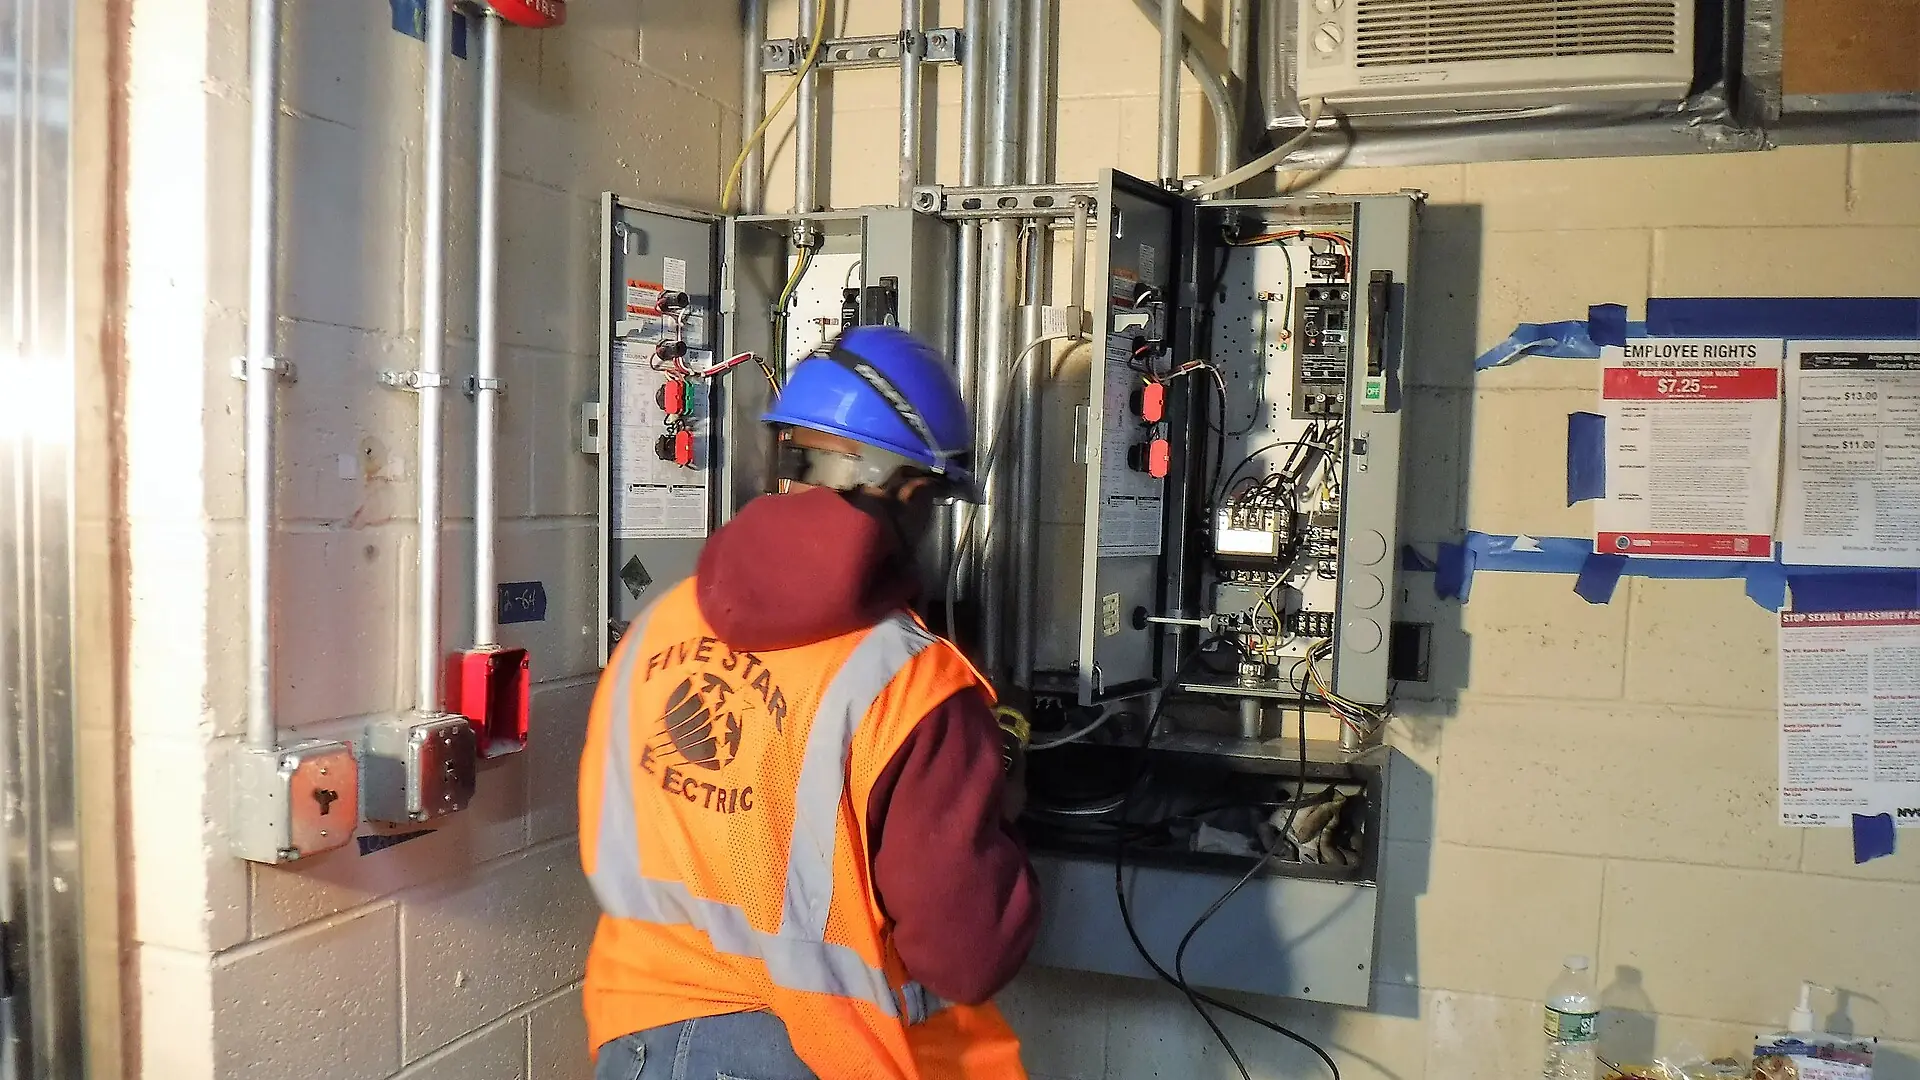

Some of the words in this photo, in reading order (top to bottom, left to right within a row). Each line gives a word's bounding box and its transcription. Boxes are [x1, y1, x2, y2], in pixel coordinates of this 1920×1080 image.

[1623, 345, 1699, 358] EMPLOYEE
[1703, 345, 1757, 358] RIGHTS
[1367, 387, 1380, 395] OFF
[1657, 378, 1701, 394] $7.25
[1844, 391, 1878, 401] $13.00
[1842, 440, 1876, 449] $11.00
[1783, 614, 1806, 623] STOP
[1808, 613, 1843, 622] SEXUAL
[1844, 612, 1907, 621] HARASSMENT
[646, 636, 717, 682] FIVE
[722, 650, 788, 736] STAR
[639, 745, 754, 814] EECTRIC
